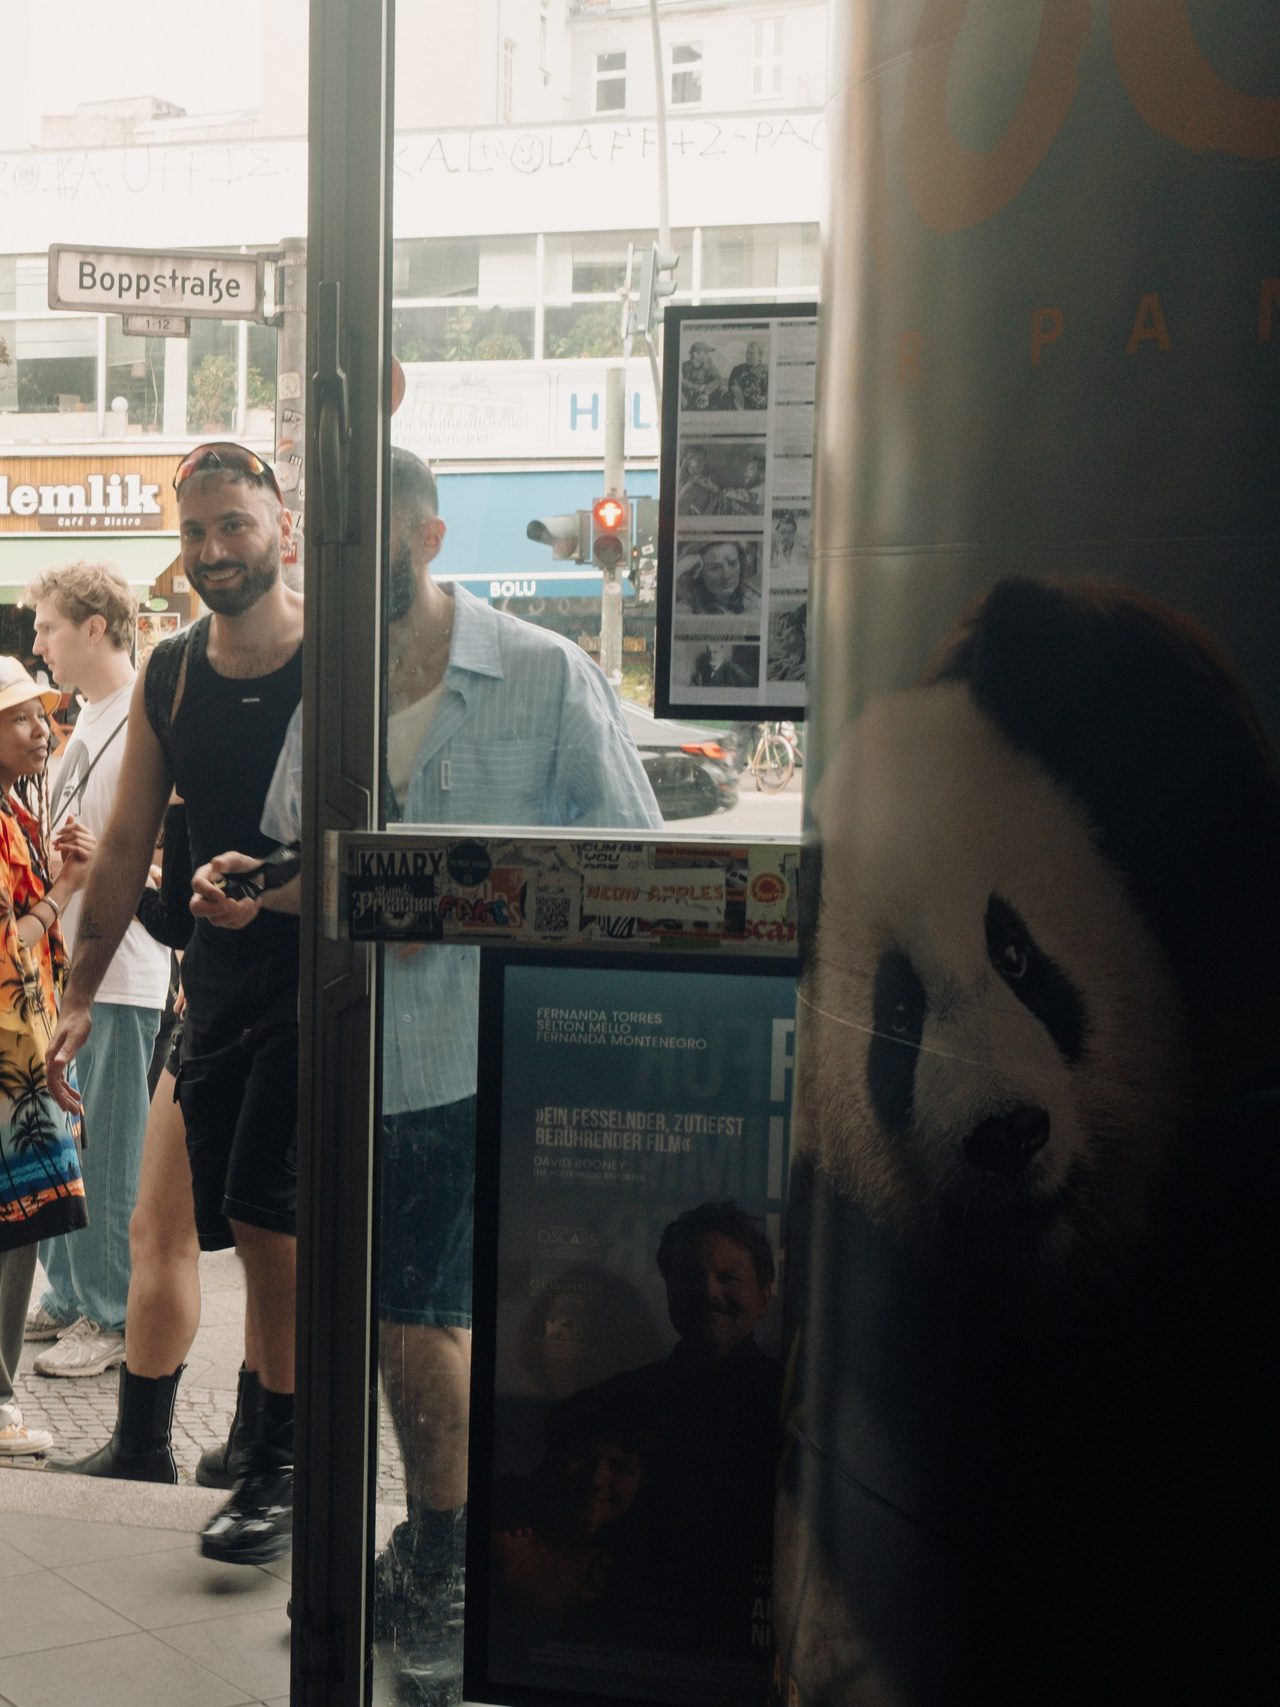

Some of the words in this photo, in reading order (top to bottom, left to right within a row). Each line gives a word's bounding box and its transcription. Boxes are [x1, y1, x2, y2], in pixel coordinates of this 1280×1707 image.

[77, 260, 242, 304] Boppstraße
[144, 317, 171, 331] 1-12
[490, 580, 537, 598] BOLU
[584, 853, 621, 862] YOU
[586, 885, 640, 902] NEON
[646, 883, 724, 904] APPLES
[536, 1007, 607, 1023] FERNANDA
[612, 1010, 663, 1025] TORRES
[536, 1019, 586, 1033] SELTON
[588, 1022, 632, 1035] MELLO
[535, 1031, 607, 1046] FERNANDA
[610, 1034, 708, 1051] MONTENEGRO
[571, 1107, 670, 1134] FESSELNDER,
[674, 1114, 746, 1137] ZUTIEFST
[535, 1125, 642, 1152] BERÜHRENDER
[533, 1156, 571, 1169] DAVID
